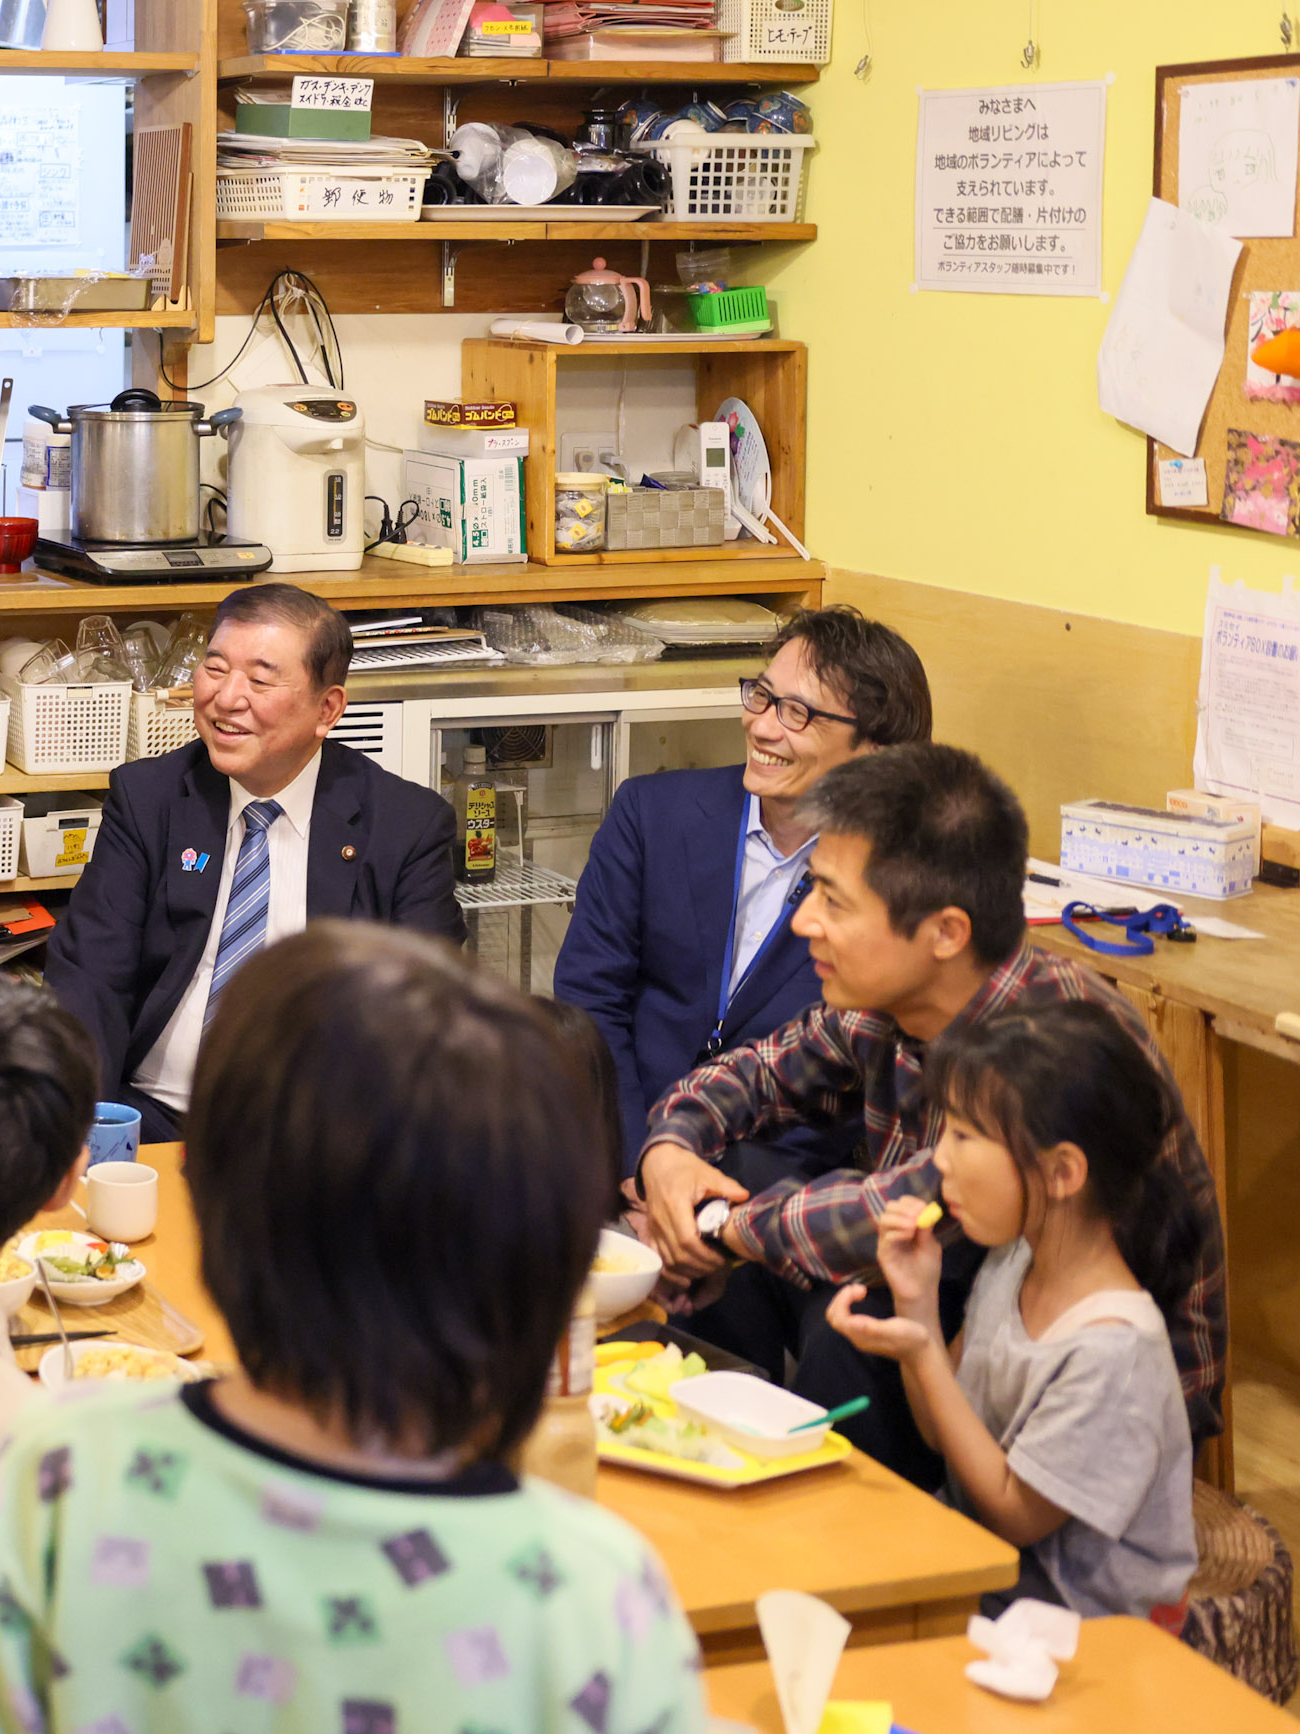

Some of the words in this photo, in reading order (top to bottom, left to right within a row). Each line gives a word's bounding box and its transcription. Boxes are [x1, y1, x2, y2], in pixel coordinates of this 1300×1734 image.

[767, 25, 813, 46] ヒモ・テープ
[978, 97, 1037, 115] みなさまへ
[968, 122, 1050, 143] 地域リビングは
[933, 150, 1088, 171] 地域のボランティアによって
[956, 178, 1056, 197] 支えられています。
[932, 206, 1088, 225] できる範囲で配膳・片付けの
[942, 233, 1067, 252] ご協力をお願いします。
[465, 410, 503, 421] ゴムバンド
[473, 809, 491, 818] ソース
[467, 819, 495, 830] ウスター
